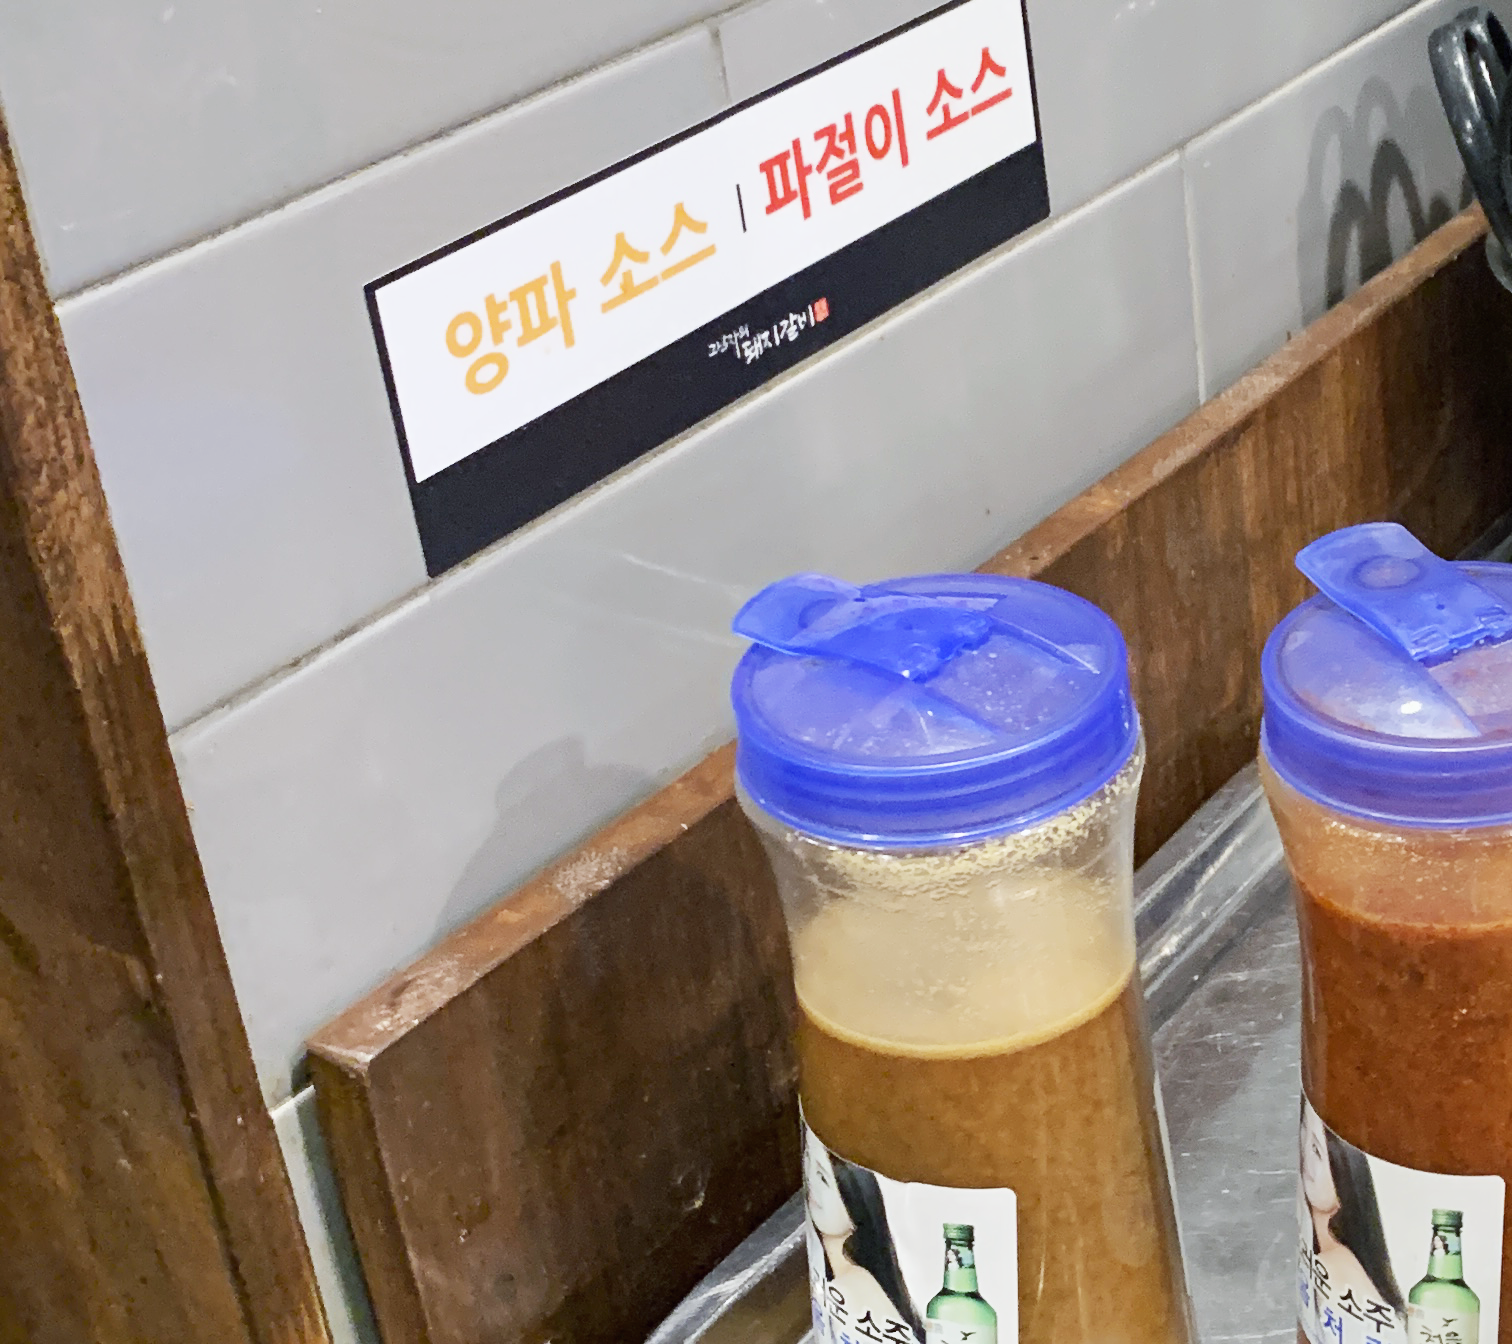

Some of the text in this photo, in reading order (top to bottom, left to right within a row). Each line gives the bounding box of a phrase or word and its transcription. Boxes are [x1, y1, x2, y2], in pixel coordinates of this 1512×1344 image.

[446, 48, 1012, 394] 양파 소스 파절이 소스
[742, 304, 815, 364] 돼지갈비
[1337, 1289, 1395, 1333] 소주
